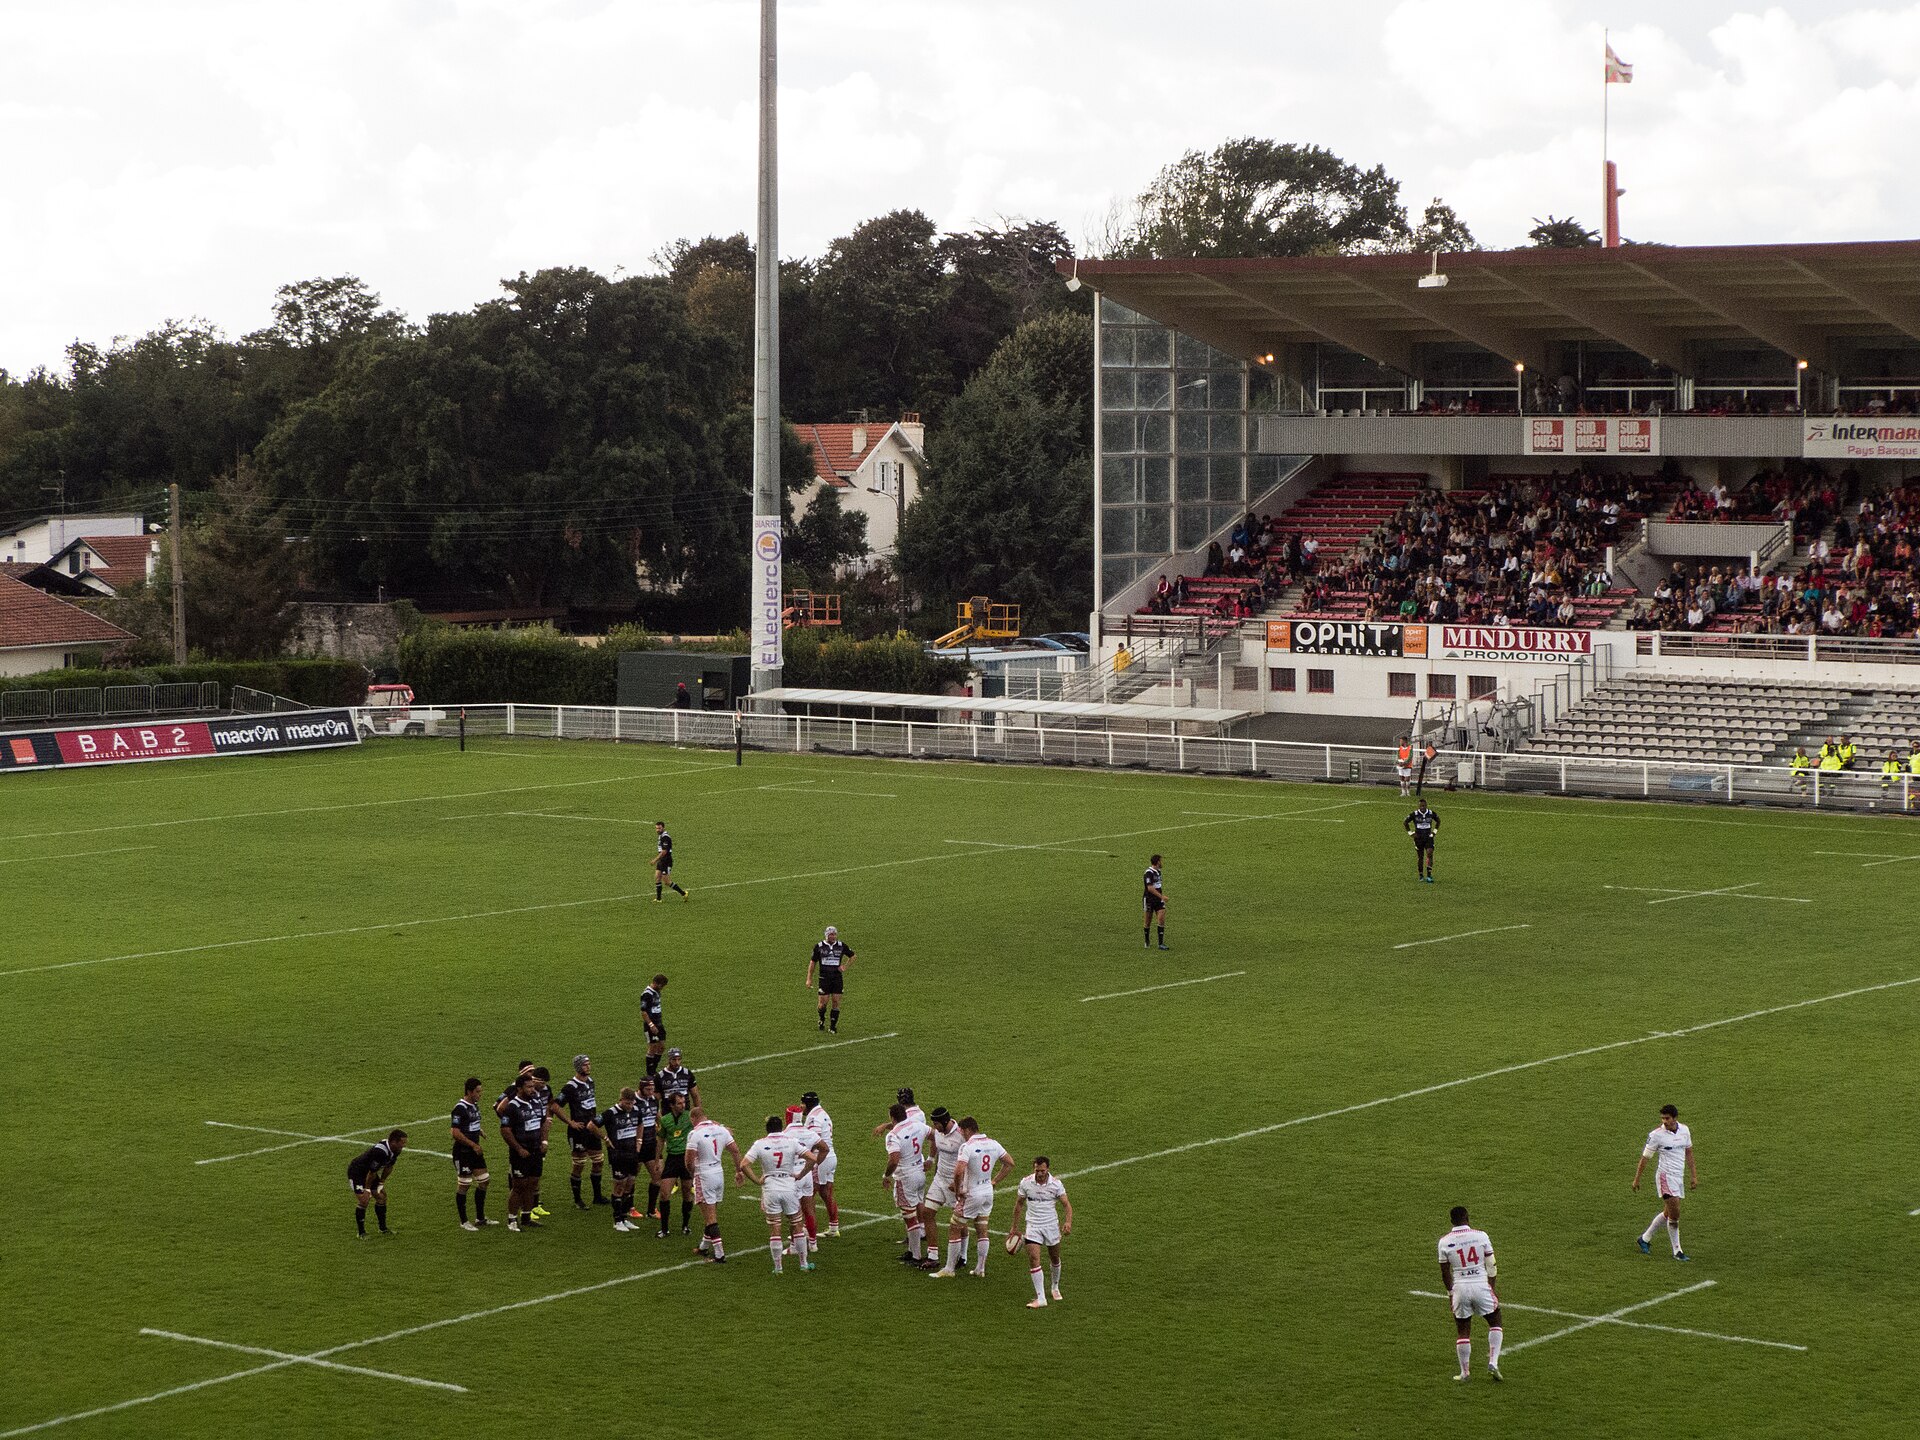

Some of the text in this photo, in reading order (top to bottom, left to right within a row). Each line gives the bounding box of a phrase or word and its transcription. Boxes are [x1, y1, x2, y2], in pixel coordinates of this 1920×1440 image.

[1533, 421, 1553, 434] SUD
[1576, 421, 1596, 434] SUD
[1619, 421, 1640, 434] SUD
[1533, 434, 1563, 448] OUEST
[1576, 434, 1606, 448] OUEST
[1619, 434, 1650, 448] OUEST
[1847, 445, 1918, 456] Pays Basque
[1446, 627, 1588, 652] MINDURRY
[1295, 645, 1398, 657] CARRELAGE
[1463, 650, 1570, 662] PROMOTION
[214, 725, 280, 745] macron
[285, 719, 349, 739] macron
[712, 1138, 718, 1156] 1
[911, 1137, 921, 1155] 5
[773, 1151, 784, 1169] 7
[981, 1154, 991, 1173] 8
[1456, 1246, 1480, 1268] 14
